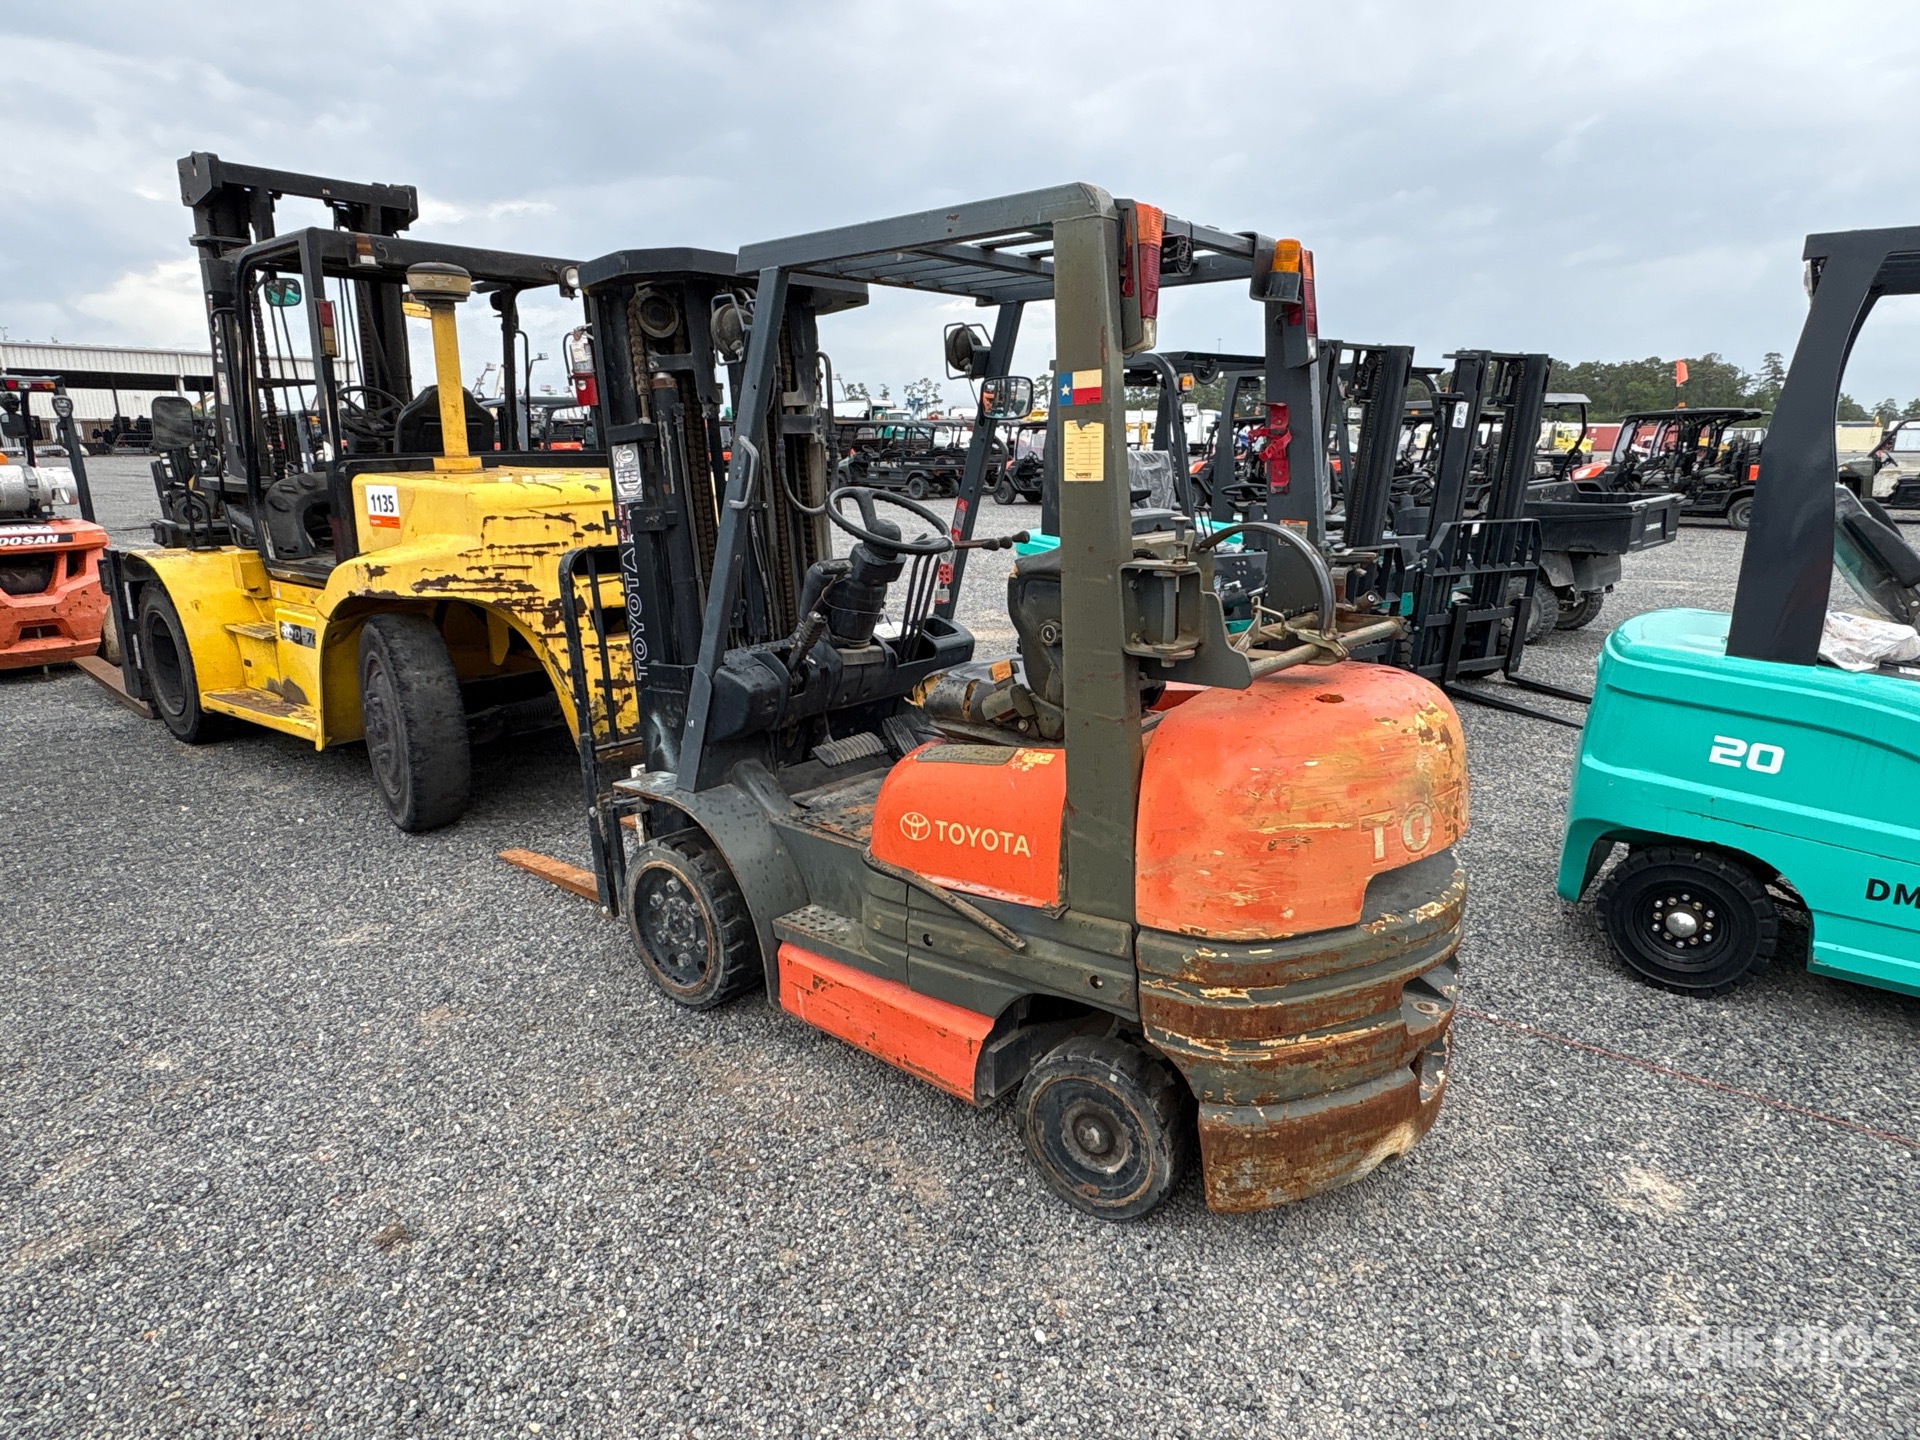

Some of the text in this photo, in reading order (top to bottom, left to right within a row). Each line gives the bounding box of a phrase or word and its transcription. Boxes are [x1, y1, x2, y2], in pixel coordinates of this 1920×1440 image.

[371, 493, 395, 513] 1135
[622, 547, 649, 681] TOYOTA
[1708, 734, 1785, 775] 20
[934, 819, 1031, 858] TOYOTA
